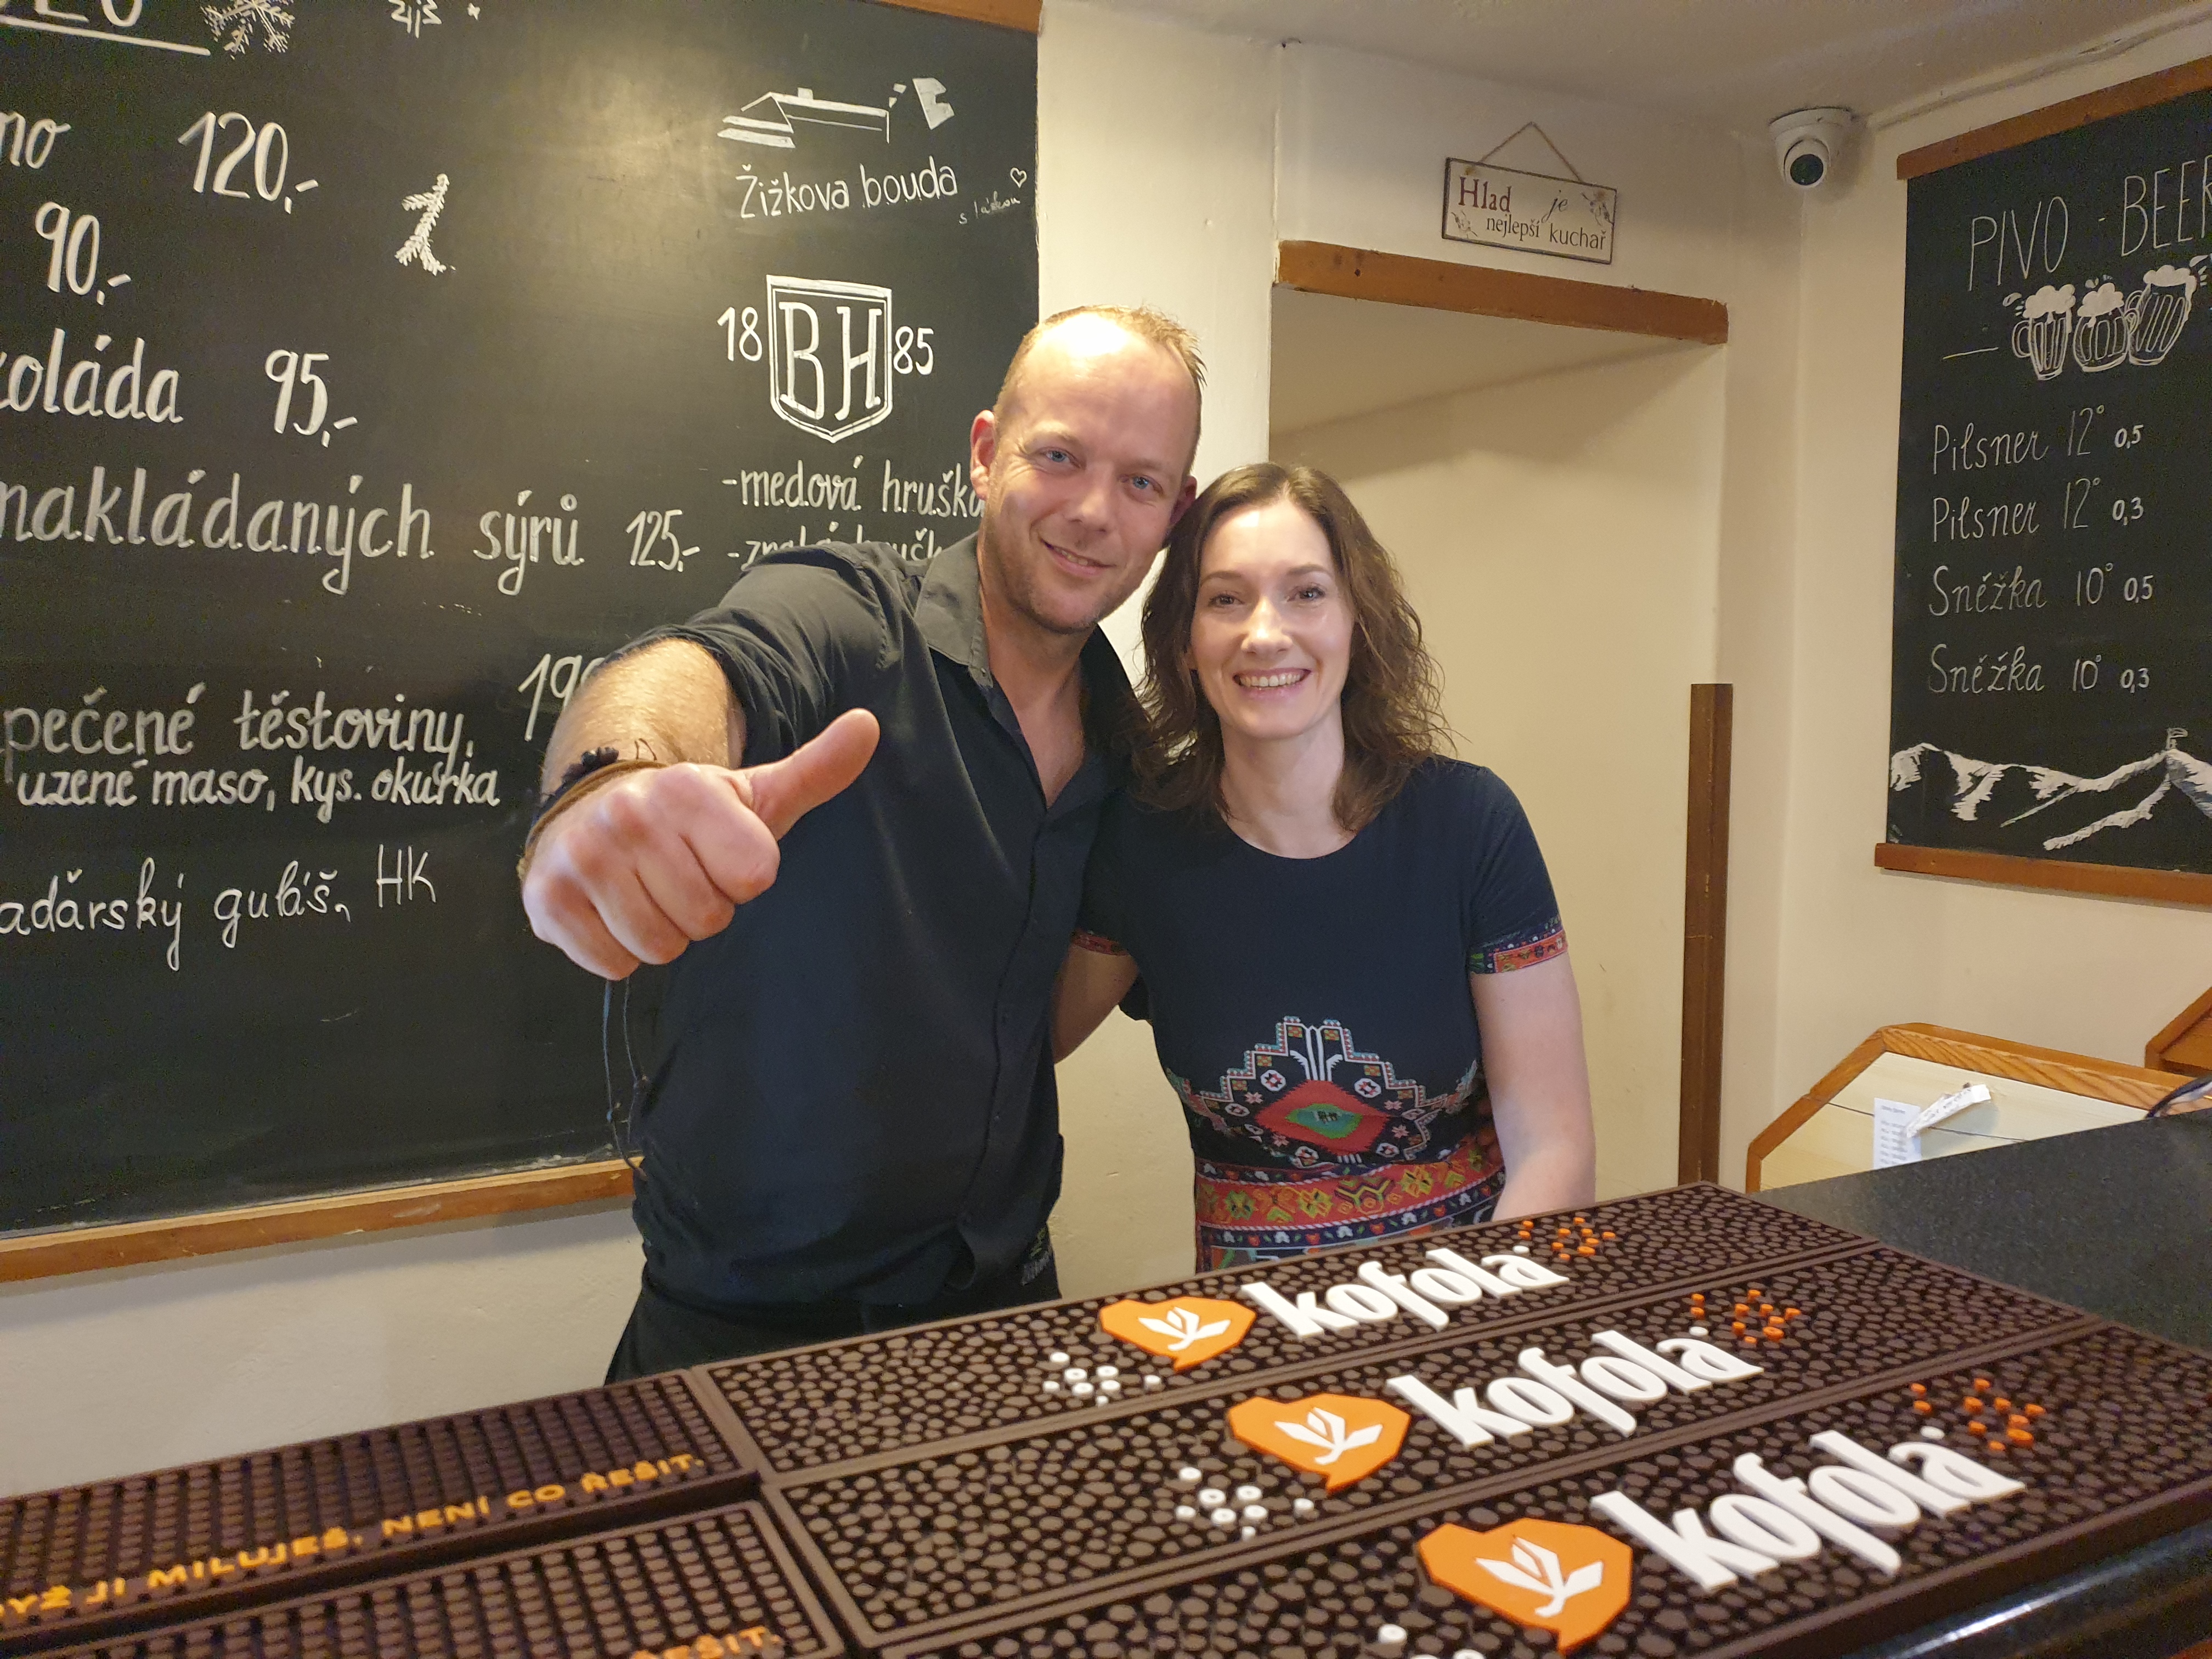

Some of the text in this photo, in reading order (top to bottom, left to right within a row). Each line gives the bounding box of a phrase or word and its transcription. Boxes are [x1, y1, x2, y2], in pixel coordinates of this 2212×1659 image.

[178, 111, 319, 215] 120,-
[735, 156, 958, 219] Žižkova bouda
[1458, 177, 1568, 223] Hlad je
[35, 201, 131, 306] 90,-
[959, 212, 968, 224] s
[1487, 214, 1606, 250] nejlepší kuchař
[1968, 196, 2068, 291] PIVO
[2121, 154, 2212, 257] BEER
[265, 349, 358, 448] 95,-
[717, 301, 934, 421] 18 BH 85
[1933, 405, 2144, 475] Pilsner 12° 0,5
[0, 466, 701, 595] nakládaných sýrů 125,-
[1933, 477, 2144, 542] Pilsner 12° 0,3
[1929, 562, 2154, 616] Sněžka 10° 0,5
[0, 653, 606, 783] pečené těstoviny, 19
[1928, 644, 2045, 693] Sněžka
[2120, 668, 2150, 693] 0,3
[17, 758, 149, 806] uzené
[152, 769, 275, 811] maso,
[291, 755, 362, 823] kys.
[213, 860, 351, 948] guláš,
[376, 844, 437, 908] HK
[1240, 1245, 1570, 1339] kofola
[1386, 1328, 1764, 1449] kofola
[85, 1581, 126, 1605] JI
[506, 1485, 566, 1508] CO
[1589, 1427, 2028, 1592] kofola
